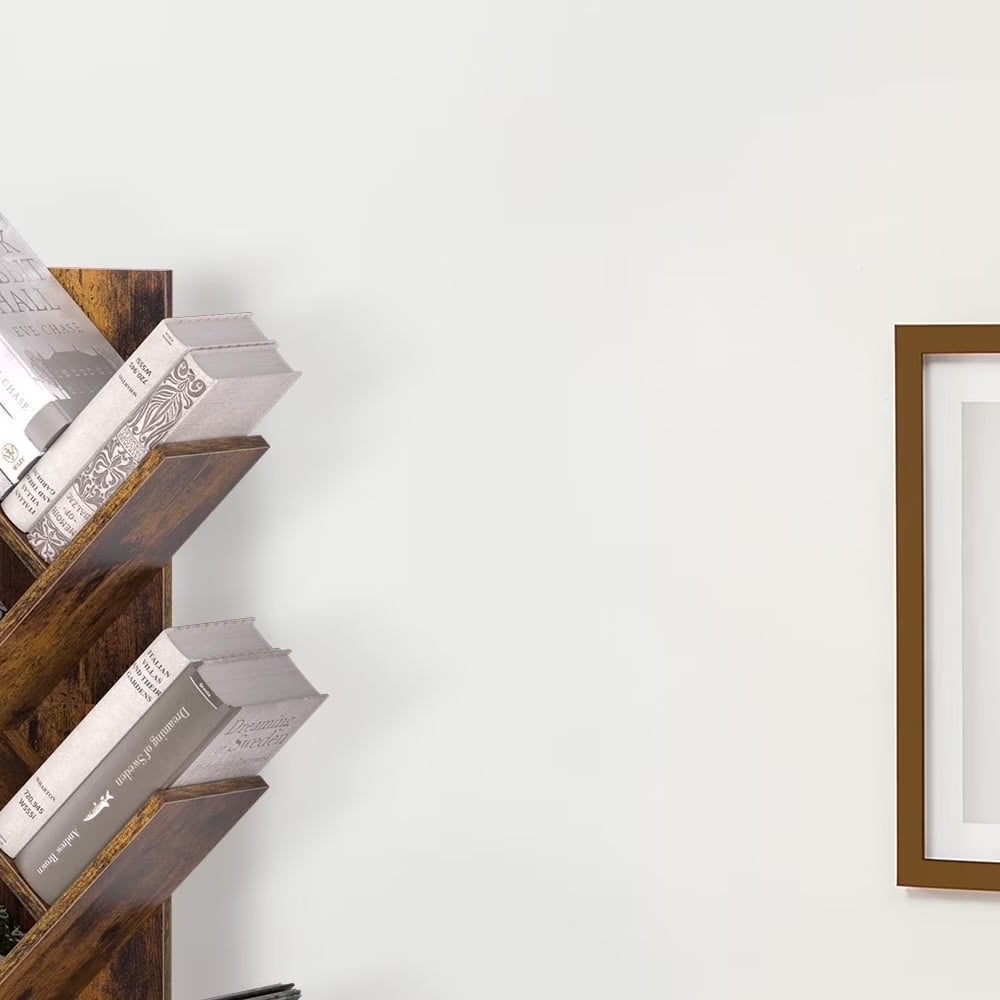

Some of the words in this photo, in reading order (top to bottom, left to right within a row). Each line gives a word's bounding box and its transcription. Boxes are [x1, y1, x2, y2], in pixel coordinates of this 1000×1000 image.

[13, 323, 40, 338] EVE
[44, 321, 84, 335] CHASE
[1, 377, 31, 411] CHASE
[22, 484, 40, 507] VILLAS
[38, 490, 51, 503] AND
[141, 658, 163, 685] VILLAS
[147, 650, 172, 679] ITALIAN
[126, 670, 153, 703] GARDENS
[140, 674, 162, 697] THEIR
[149, 706, 190, 747] Dreaming
[143, 744, 153, 760] of
[115, 754, 148, 786] Sweden
[23, 788, 45, 815] 720.945
[56, 828, 80, 852] Andrew
[36, 852, 58, 874] Brown
